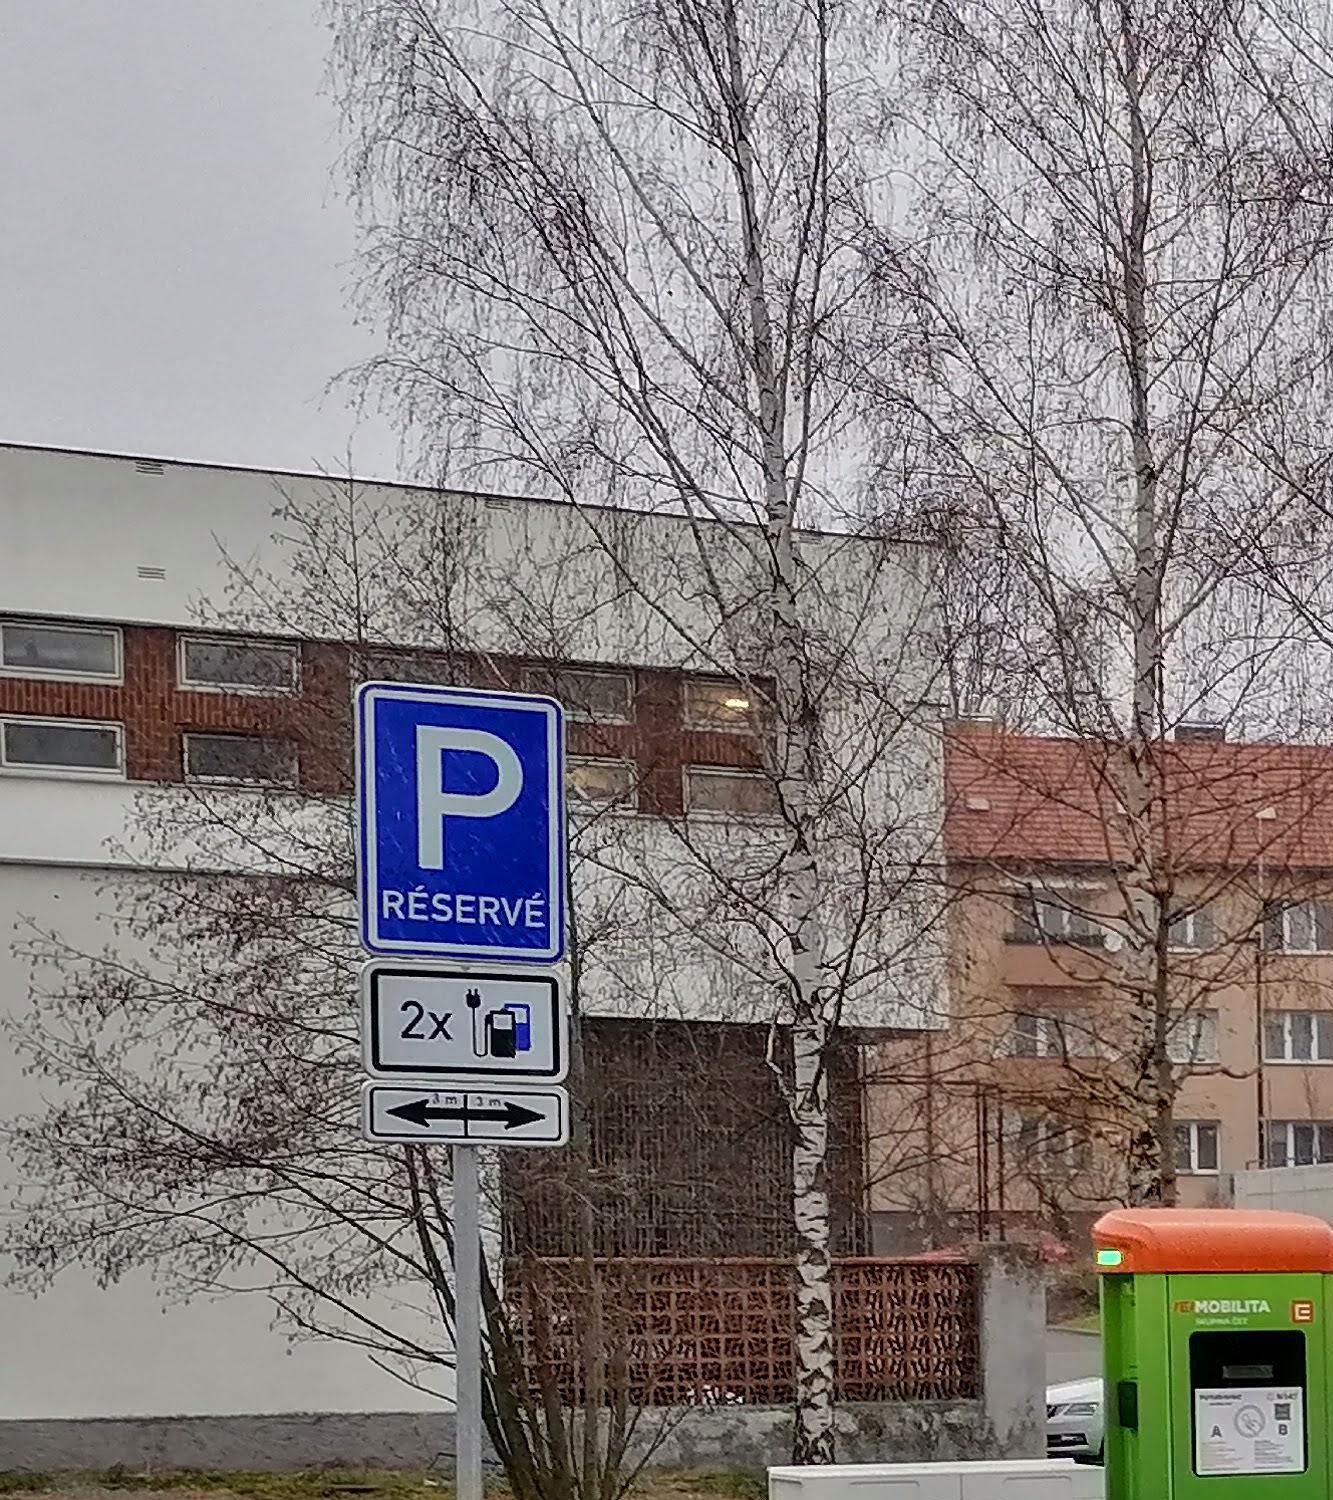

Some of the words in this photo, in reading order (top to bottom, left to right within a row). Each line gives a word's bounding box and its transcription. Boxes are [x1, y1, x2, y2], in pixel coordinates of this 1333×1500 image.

[416, 724, 524, 871] P
[382, 885, 546, 929] RÉSERVÉ
[400, 999, 453, 1041] 2x
[445, 1095, 458, 1105] m
[1211, 1425, 1222, 1438] A
[1278, 1424, 1288, 1435] B
